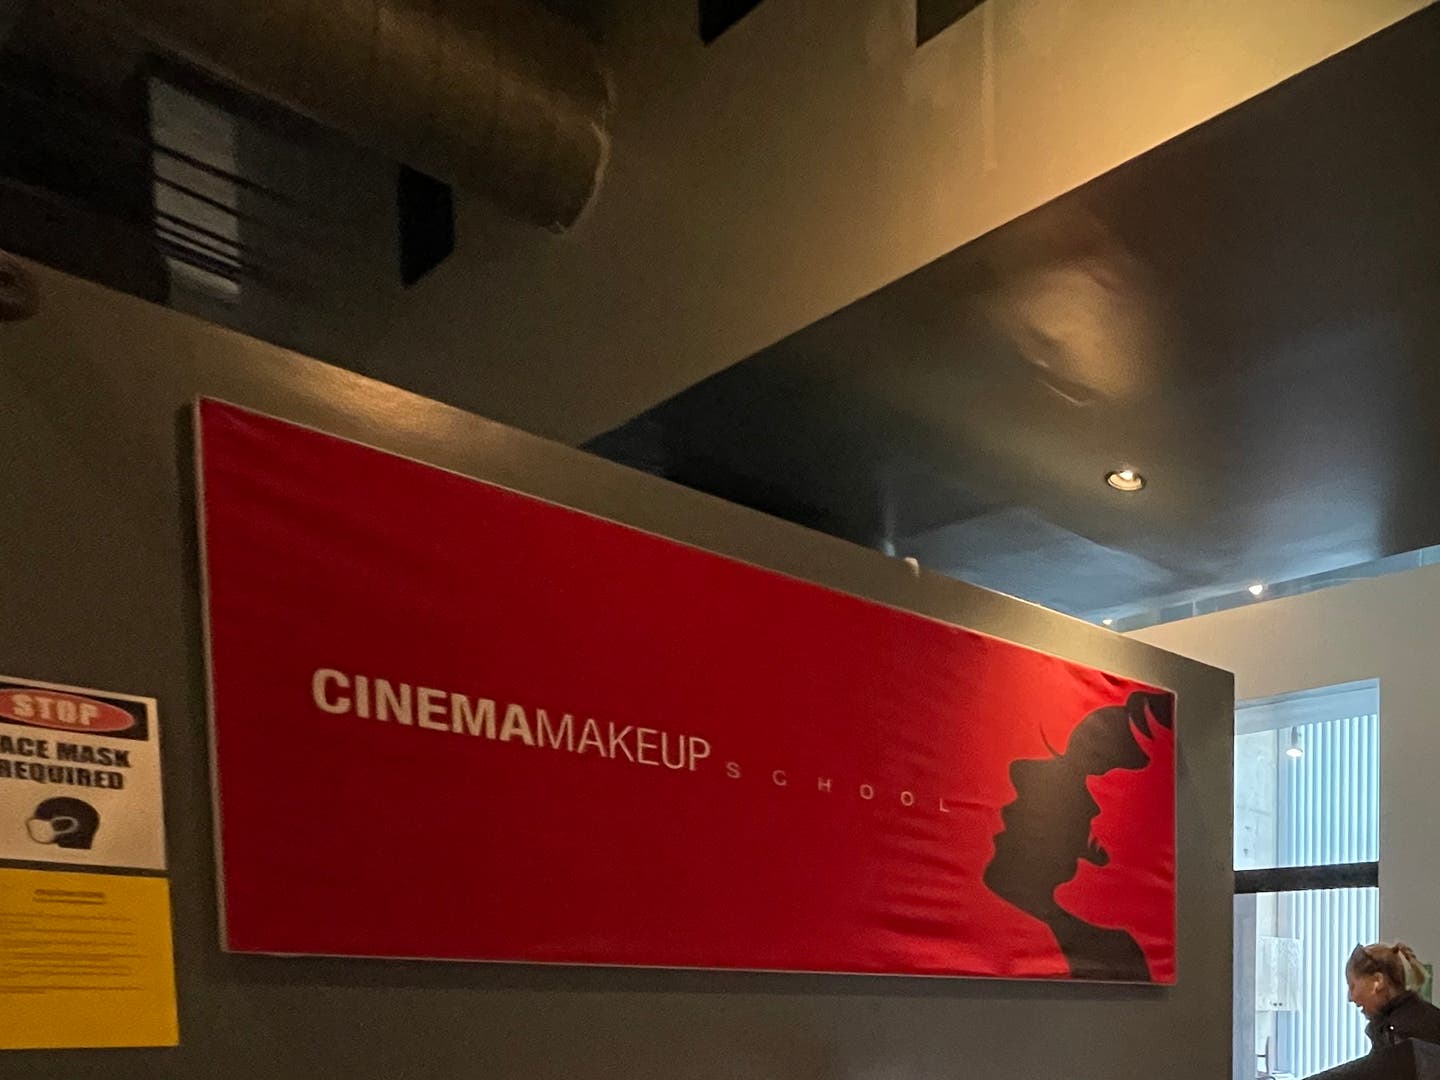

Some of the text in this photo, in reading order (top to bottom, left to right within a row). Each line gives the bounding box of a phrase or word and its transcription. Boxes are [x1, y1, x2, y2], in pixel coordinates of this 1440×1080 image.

[11, 693, 99, 726] STOP
[0, 735, 131, 768] ACE MASK
[0, 758, 124, 790] REQUIRED
[725, 760, 951, 813] SCHOOL
